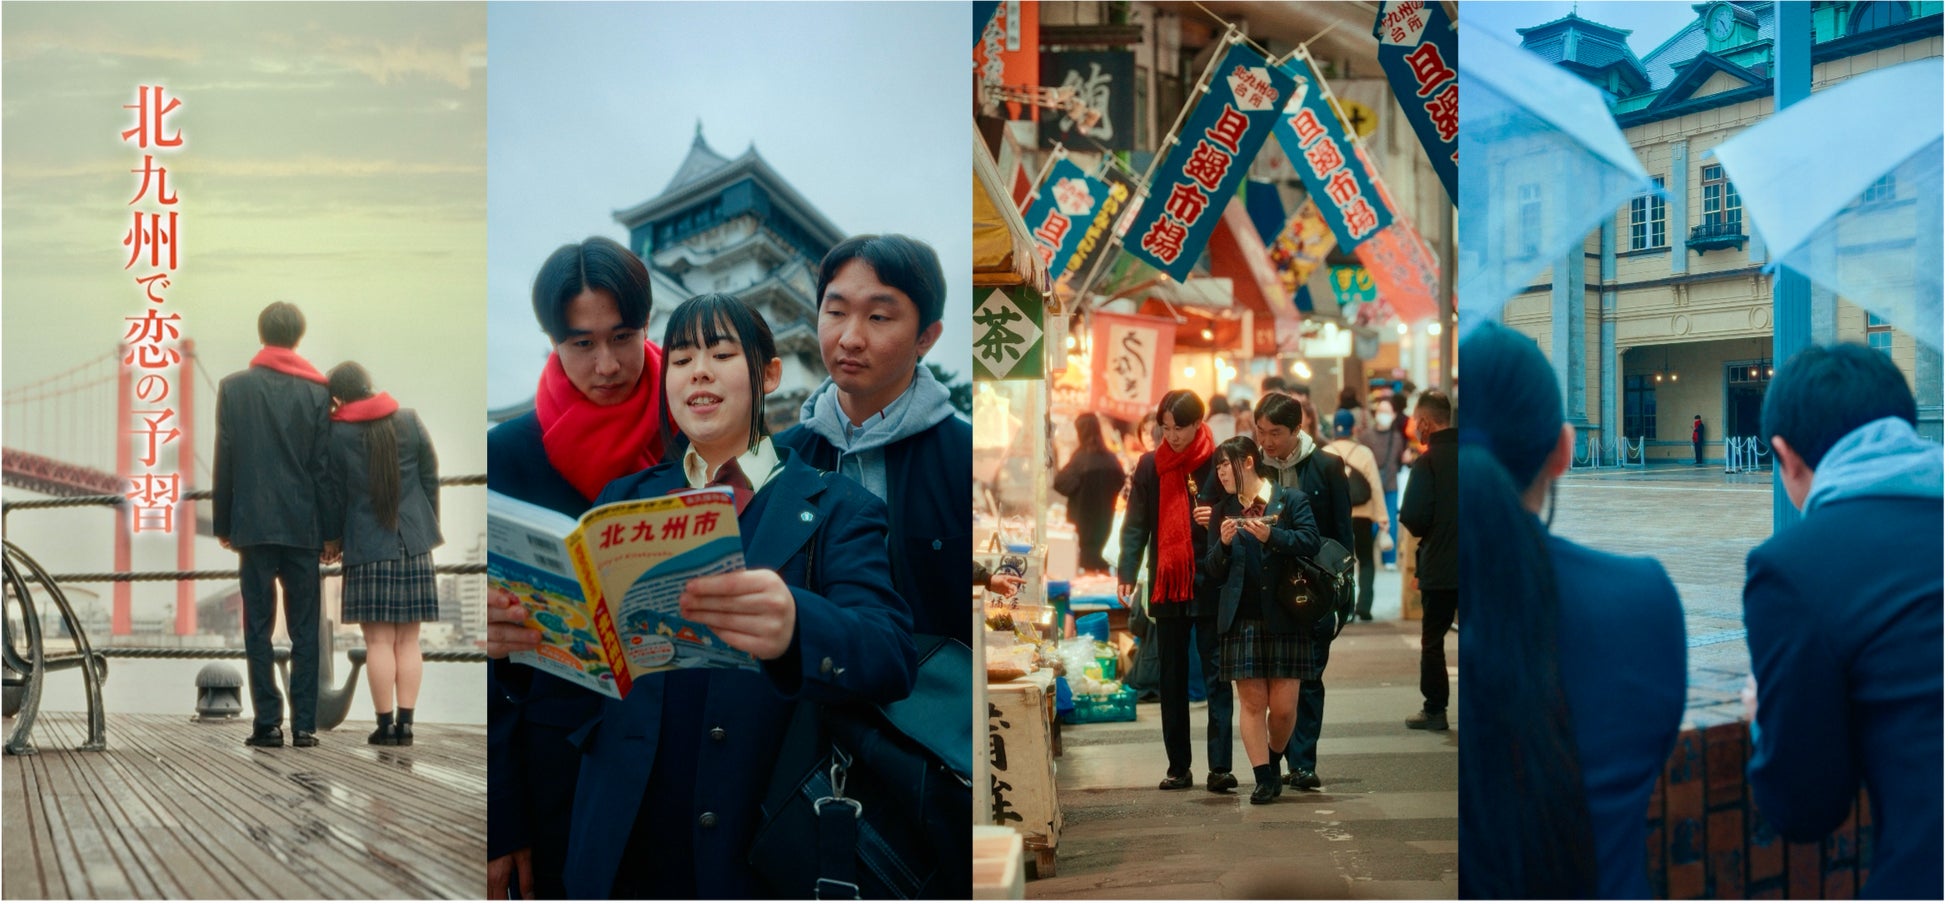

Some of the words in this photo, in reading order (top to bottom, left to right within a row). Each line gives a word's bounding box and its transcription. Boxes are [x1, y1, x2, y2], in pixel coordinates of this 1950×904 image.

[1380, 1, 1424, 34] 九州の
[1391, 14, 1423, 43] 台所
[1232, 65, 1279, 102] 北九州の
[1234, 83, 1263, 108] 台所
[1403, 41, 1458, 167] 旦過
[1142, 103, 1250, 264] 旦過市場
[1288, 107, 1378, 239] 旦過市場
[972, 305, 1025, 364] 茶
[1112, 330, 1147, 399] うなぎ
[599, 510, 721, 549] 北九州市
